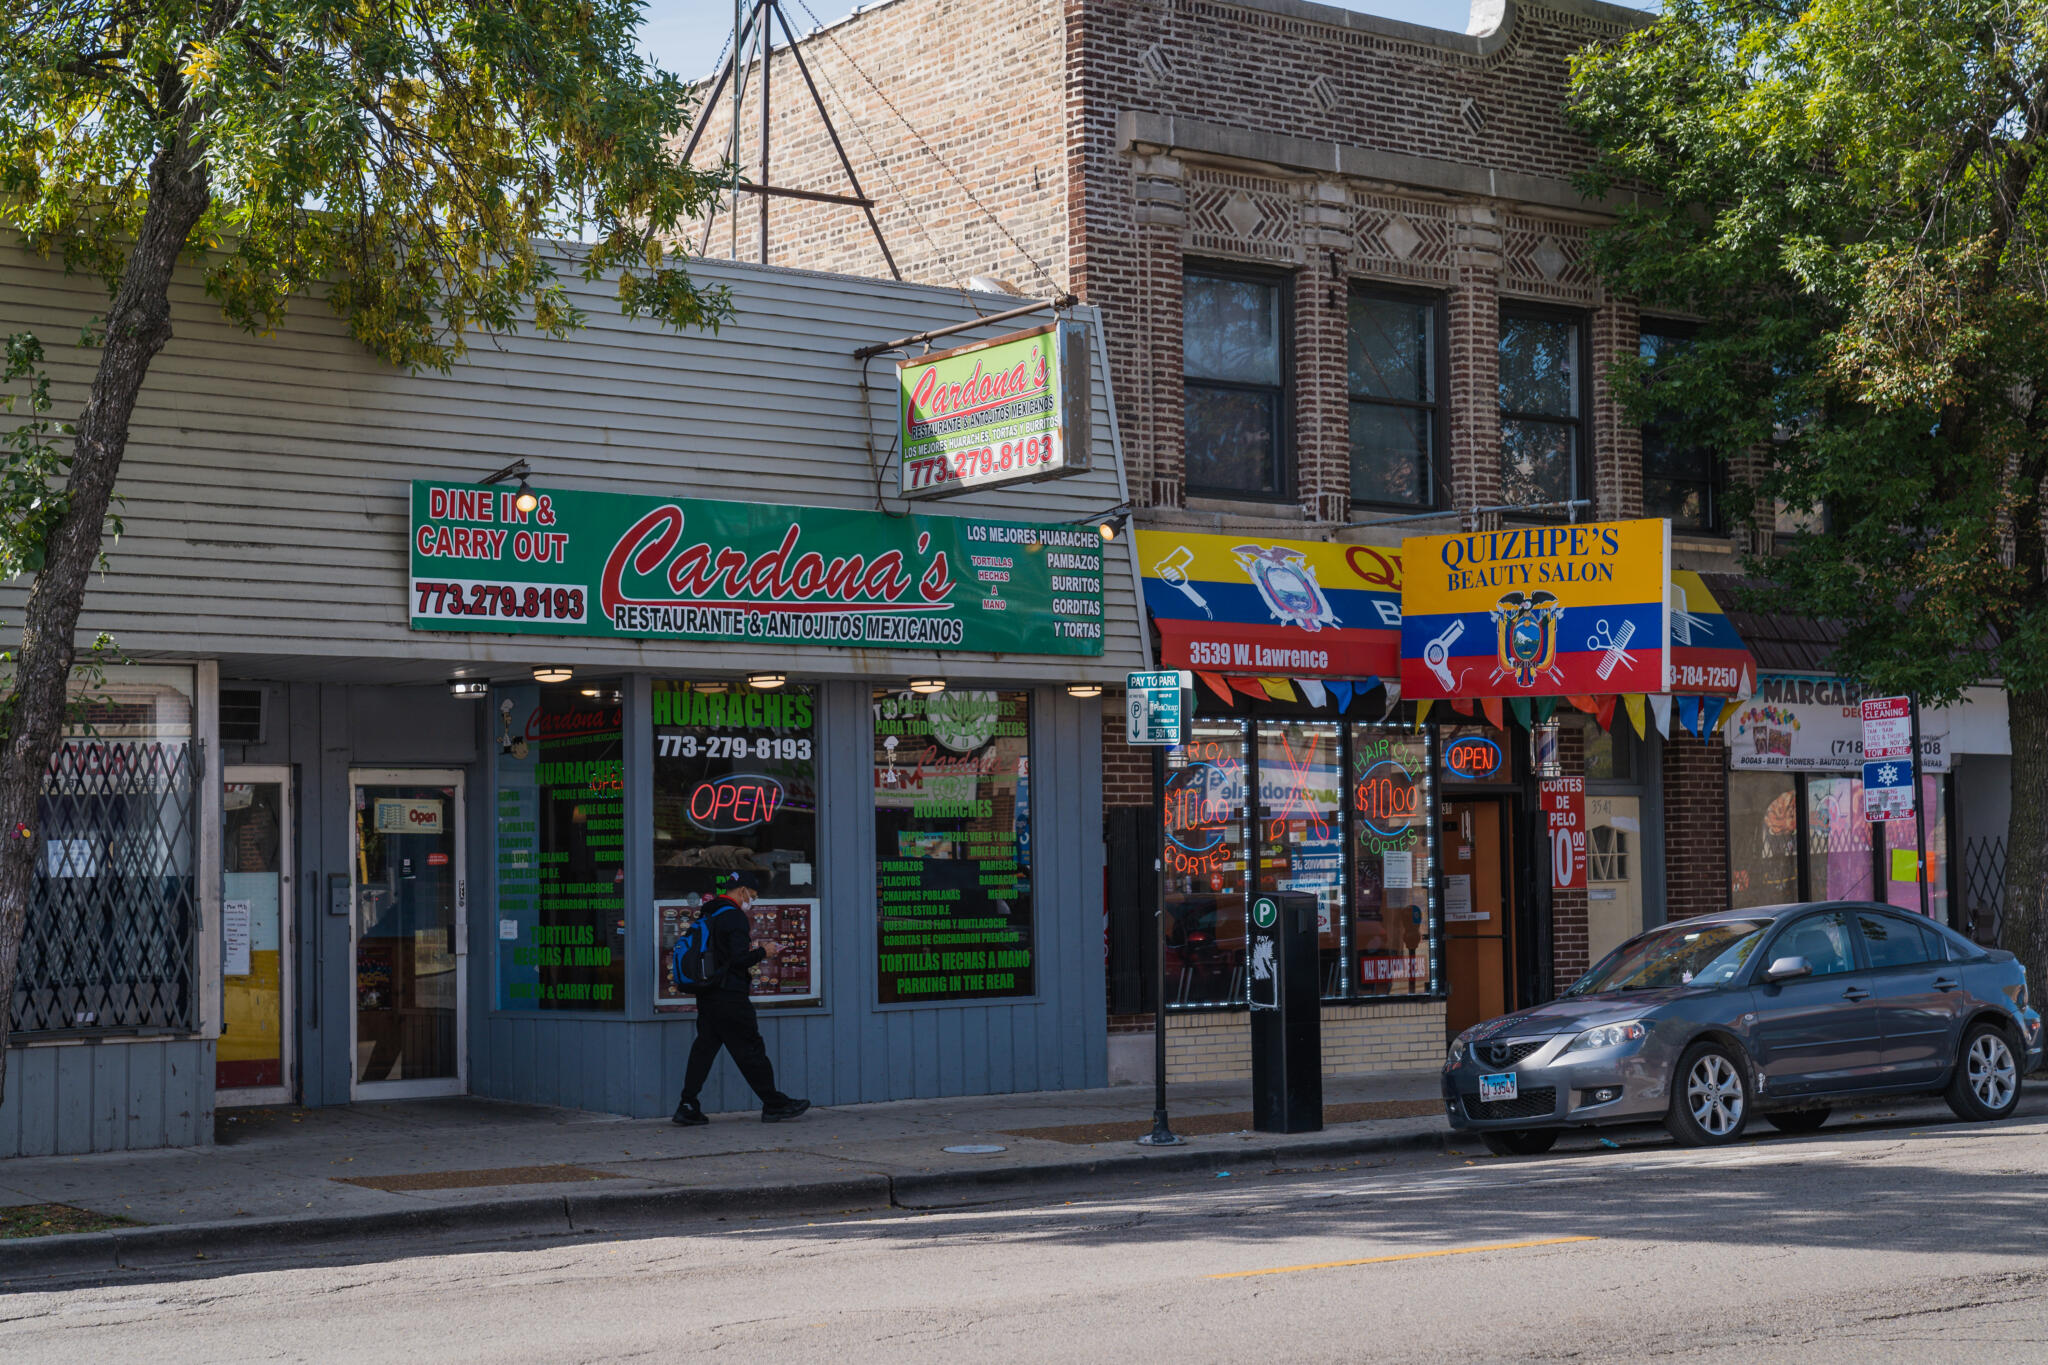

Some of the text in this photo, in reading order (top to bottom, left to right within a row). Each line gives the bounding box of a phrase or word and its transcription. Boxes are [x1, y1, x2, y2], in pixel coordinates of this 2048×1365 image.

[907, 346, 1050, 435] Cardona's
[912, 395, 1054, 440] RESTAURANTE & ANTOJITOS MEXICANOS
[904, 446, 917, 459] LOS
[918, 440, 947, 456] MEJORES
[992, 426, 1018, 441] TORTAS
[1025, 415, 1059, 433] BURRITOS
[909, 434, 1053, 488] 773.279.8193
[430, 488, 556, 526] DINE IN &
[416, 525, 568, 563] CARRY OUT
[967, 525, 1099, 548] LOS MEJORES HUARACHES
[1441, 527, 1619, 571] QUIZHPE'S
[601, 504, 956, 618] Cardona's
[971, 555, 1013, 568] TORTILLAS
[1047, 553, 1099, 571] PAMBAZOS
[978, 570, 1009, 582] HECHAS
[1052, 576, 1100, 593] BURRITOS
[1448, 561, 1614, 592] BEAUTY SALON
[991, 585, 998, 596] A
[416, 583, 584, 619] 773.279.8193
[982, 599, 1006, 610] MANO
[1053, 599, 1100, 615] GORDITAS
[614, 604, 963, 643] RESTAURANTE & ANTOJITOS MEXICANOS
[1054, 622, 1100, 638] Y TORTAS
[1190, 641, 1328, 669] 3539 W. Lawrence
[1131, 675, 1176, 687] PAY TO PARK
[653, 691, 812, 728] HUARACHES
[1865, 701, 1891, 711] STREET
[1865, 708, 1904, 719] CLEANING
[875, 719, 904, 735] PARA
[905, 720, 934, 735] TODO
[658, 735, 811, 759] 773-279-8193
[1867, 747, 1907, 757] TOW ZONE
[1353, 739, 1423, 777] HAIR CUT
[1451, 747, 1493, 769] OPEN
[1767, 757, 1783, 765] BABY
[1785, 758, 1815, 766] SHOWERS
[1819, 758, 1850, 767] BAUTIZOS
[535, 760, 623, 784] HUARACHES
[1541, 778, 1582, 793] CORTES
[691, 783, 777, 822] OPEN
[914, 799, 993, 818] HUARACHES
[1556, 796, 1570, 809] DE
[409, 809, 437, 825] Open
[1550, 812, 1576, 827] PELO
[883, 861, 924, 871] PAMBAZOS
[979, 860, 1018, 871] MARISCOS
[1164, 843, 1231, 875] CORTES
[883, 876, 921, 886] TLACOYOS
[979, 875, 1018, 885] BARBACOA
[883, 889, 960, 901] CHALUPAS POBLANAS
[988, 889, 1018, 899] MENUDO
[883, 905, 912, 916] TORTAS
[913, 905, 938, 916] ESTILO
[1260, 903, 1270, 922] P
[883, 920, 932, 932] QUESADILLAS
[934, 919, 951, 930] FLOR
[952, 919, 958, 930] Y
[530, 925, 594, 945] TORTILLAS
[884, 932, 1019, 946] GORDITAS DE CHICHARRON PRENSADO
[514, 947, 612, 966] HECHAS A MANO
[880, 950, 1030, 972] TORTILLAS HECHAS A MANO
[556, 984, 591, 1000] CARRY
[592, 984, 614, 1000] OUT
[897, 973, 1014, 994] PARKING IN THE REAR
